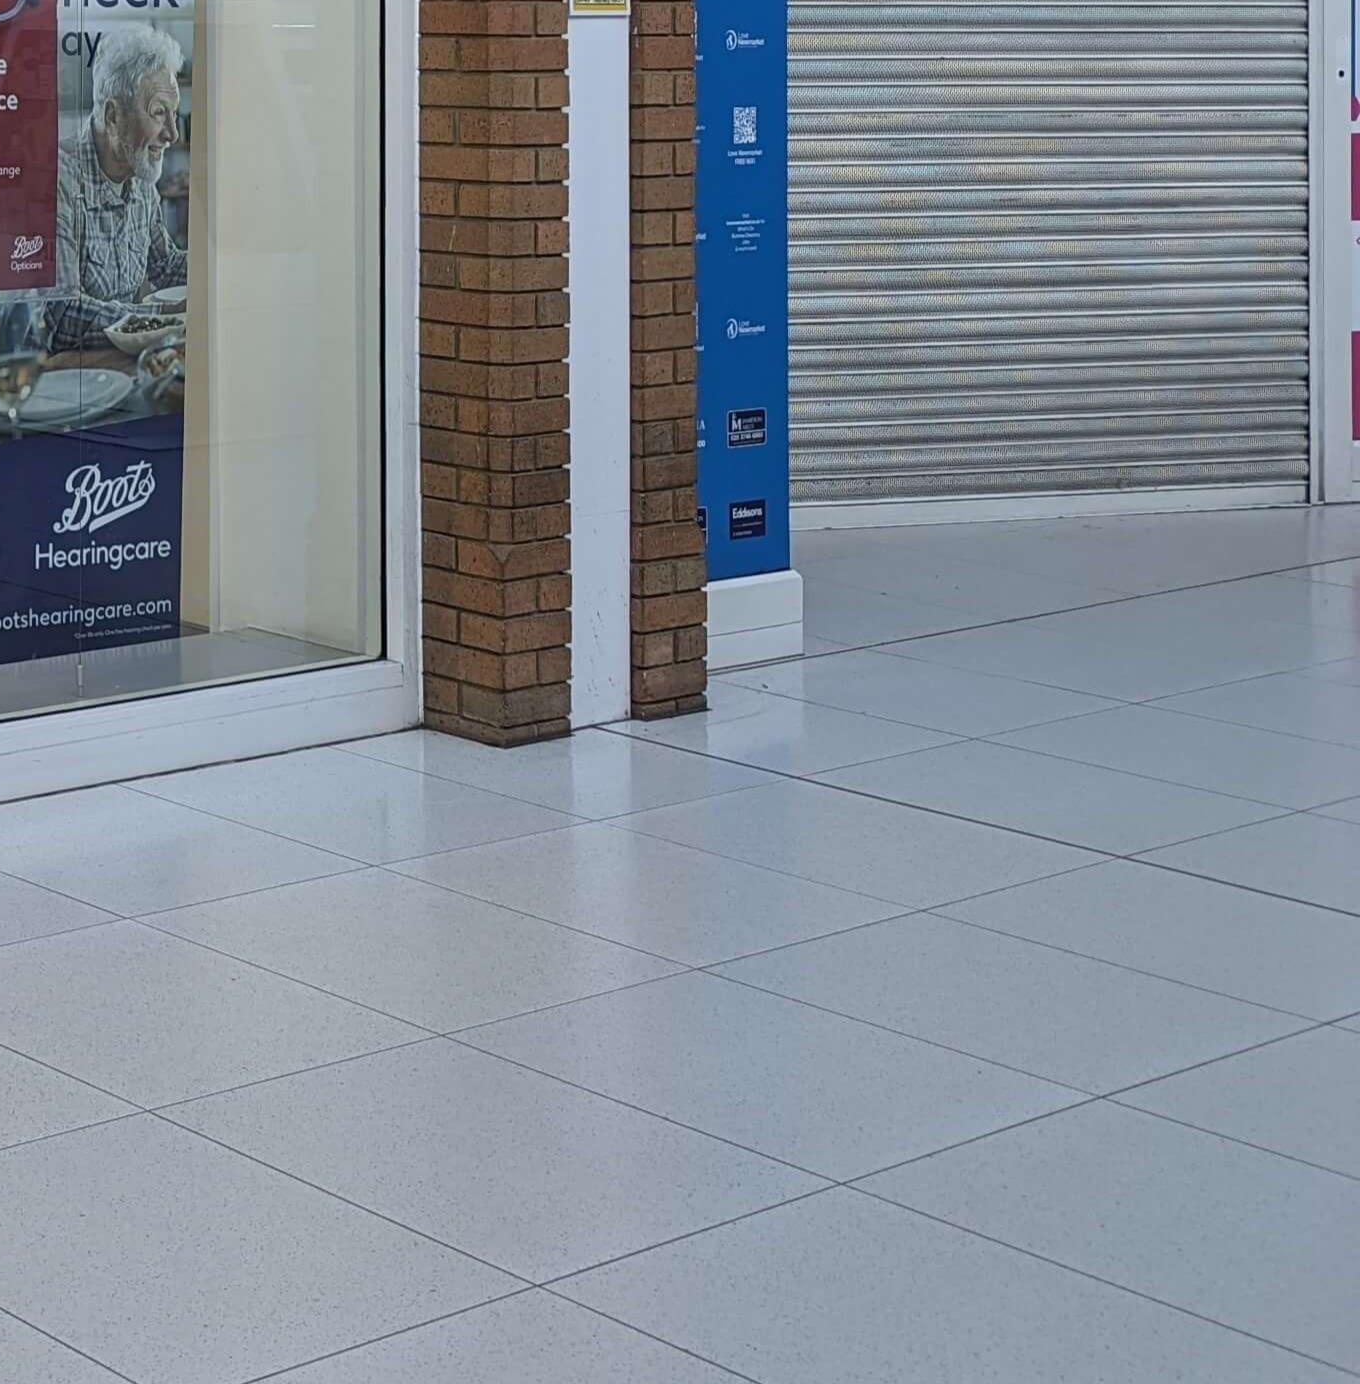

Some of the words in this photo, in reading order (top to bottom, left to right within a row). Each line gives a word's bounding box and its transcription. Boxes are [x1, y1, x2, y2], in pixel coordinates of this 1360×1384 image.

[10, 234, 44, 261] Boots
[10, 260, 43, 274] Opticians
[52, 460, 156, 534] Boots
[34, 538, 172, 571] Hearingcare
